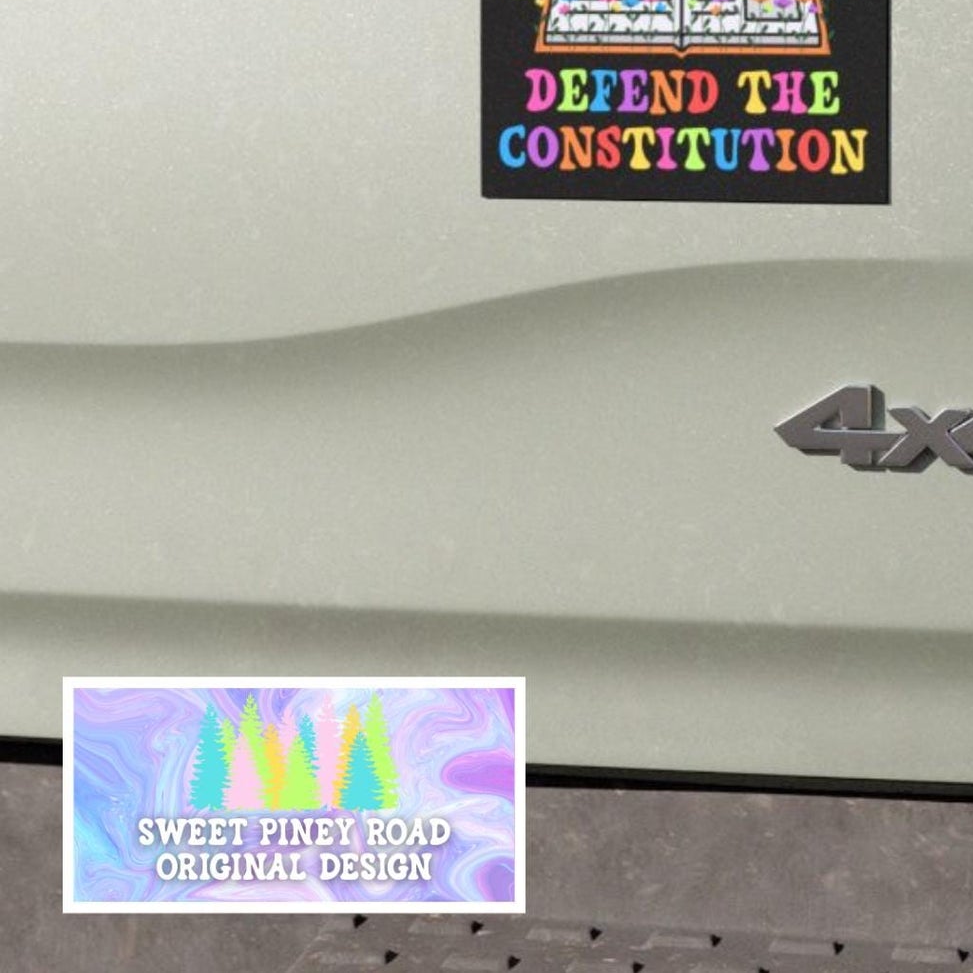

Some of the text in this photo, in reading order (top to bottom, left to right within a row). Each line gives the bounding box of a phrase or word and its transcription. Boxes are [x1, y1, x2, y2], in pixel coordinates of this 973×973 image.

[524, 68, 841, 115] DEFEND THE
[499, 124, 868, 175] CONSTITUTION
